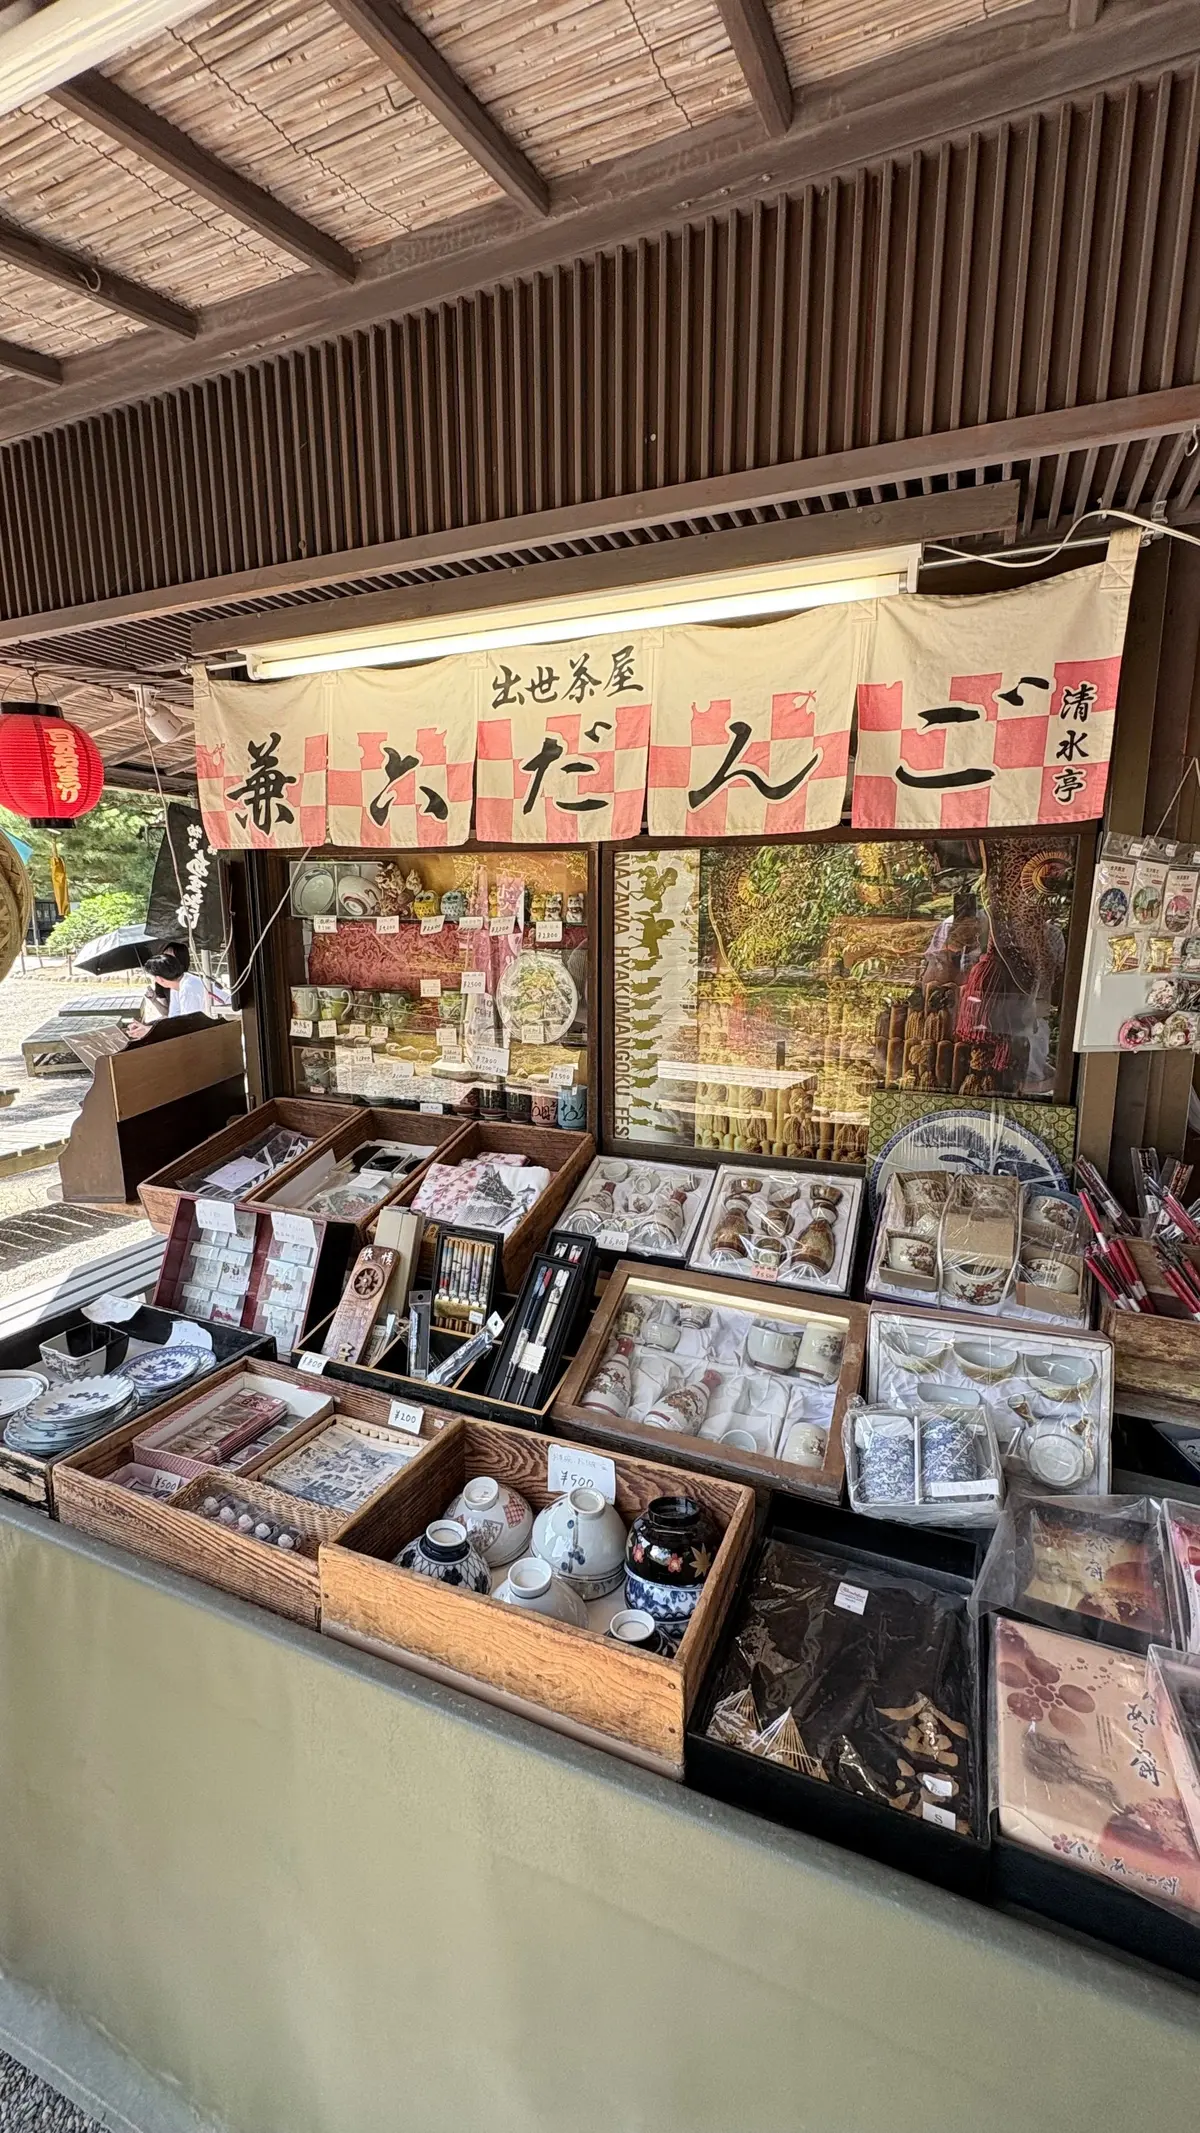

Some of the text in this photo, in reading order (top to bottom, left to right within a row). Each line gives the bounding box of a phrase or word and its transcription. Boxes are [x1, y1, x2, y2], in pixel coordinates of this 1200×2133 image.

[491, 645, 644, 709] 出世茶屋
[227, 676, 1049, 835] 兼六だんご
[1053, 683, 1097, 803] 清水亭
[614, 948, 630, 1096] HYAKUMANGOKU
[614, 1107, 630, 1140] FES
[394, 1409, 417, 1424] ¥200
[154, 1476, 177, 1491] ¥500
[560, 1470, 594, 1488] ¥500
[934, 1813, 944, 1825] S
